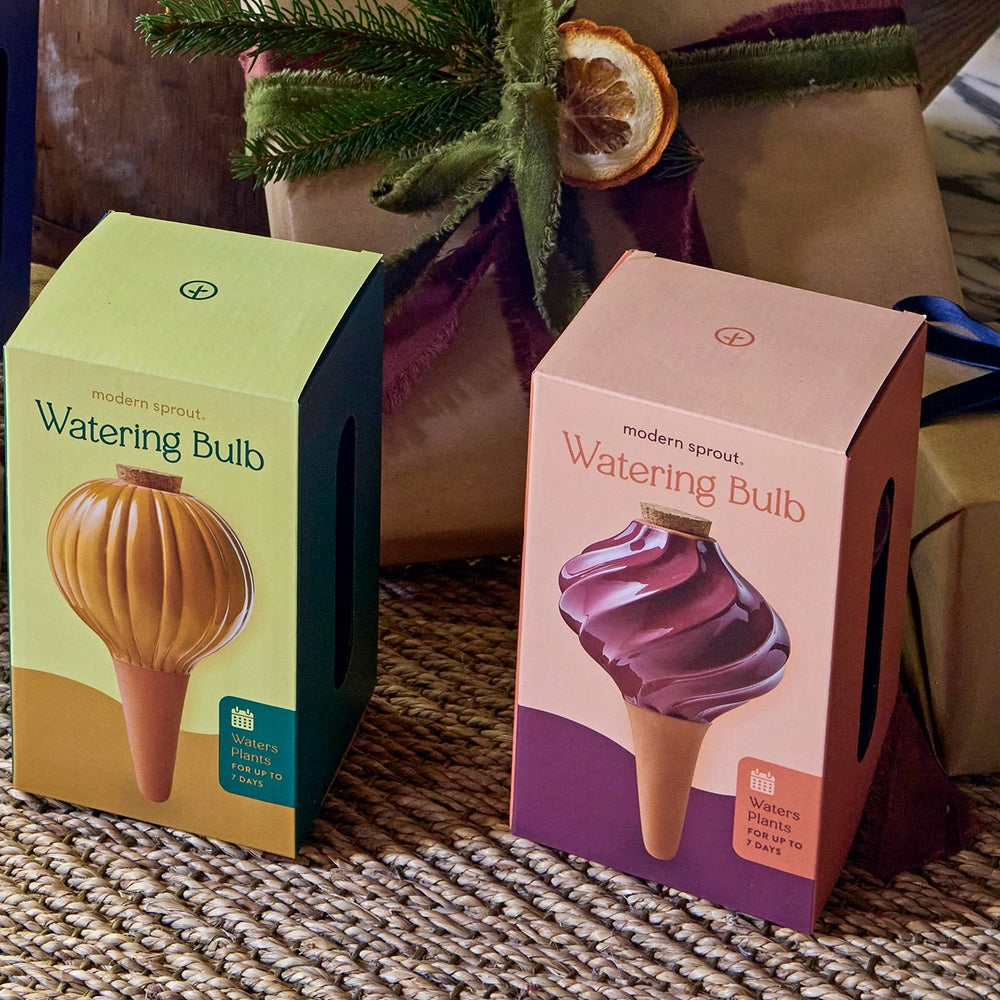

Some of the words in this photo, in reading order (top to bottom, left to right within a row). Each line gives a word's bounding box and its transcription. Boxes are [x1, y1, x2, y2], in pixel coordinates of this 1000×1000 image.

[92, 389, 149, 410] modern
[35, 399, 182, 463] Watering
[192, 430, 265, 471] Bulb
[623, 424, 684, 449] modern
[562, 430, 717, 508] Watering
[728, 475, 806, 523] Bulb
[231, 732, 279, 754] Waters
[231, 746, 271, 766] Plants
[231, 762, 251, 773] FOR
[254, 768, 267, 777] UP
[270, 772, 283, 781] TO
[239, 776, 264, 788] DAYS
[749, 795, 801, 821] Waters
[748, 810, 792, 834] Plants
[746, 838, 752, 846] 7
[755, 841, 781, 856] DAYS
[747, 827, 769, 840] FOR
[772, 835, 786, 844] UP
[789, 839, 803, 850] TO
